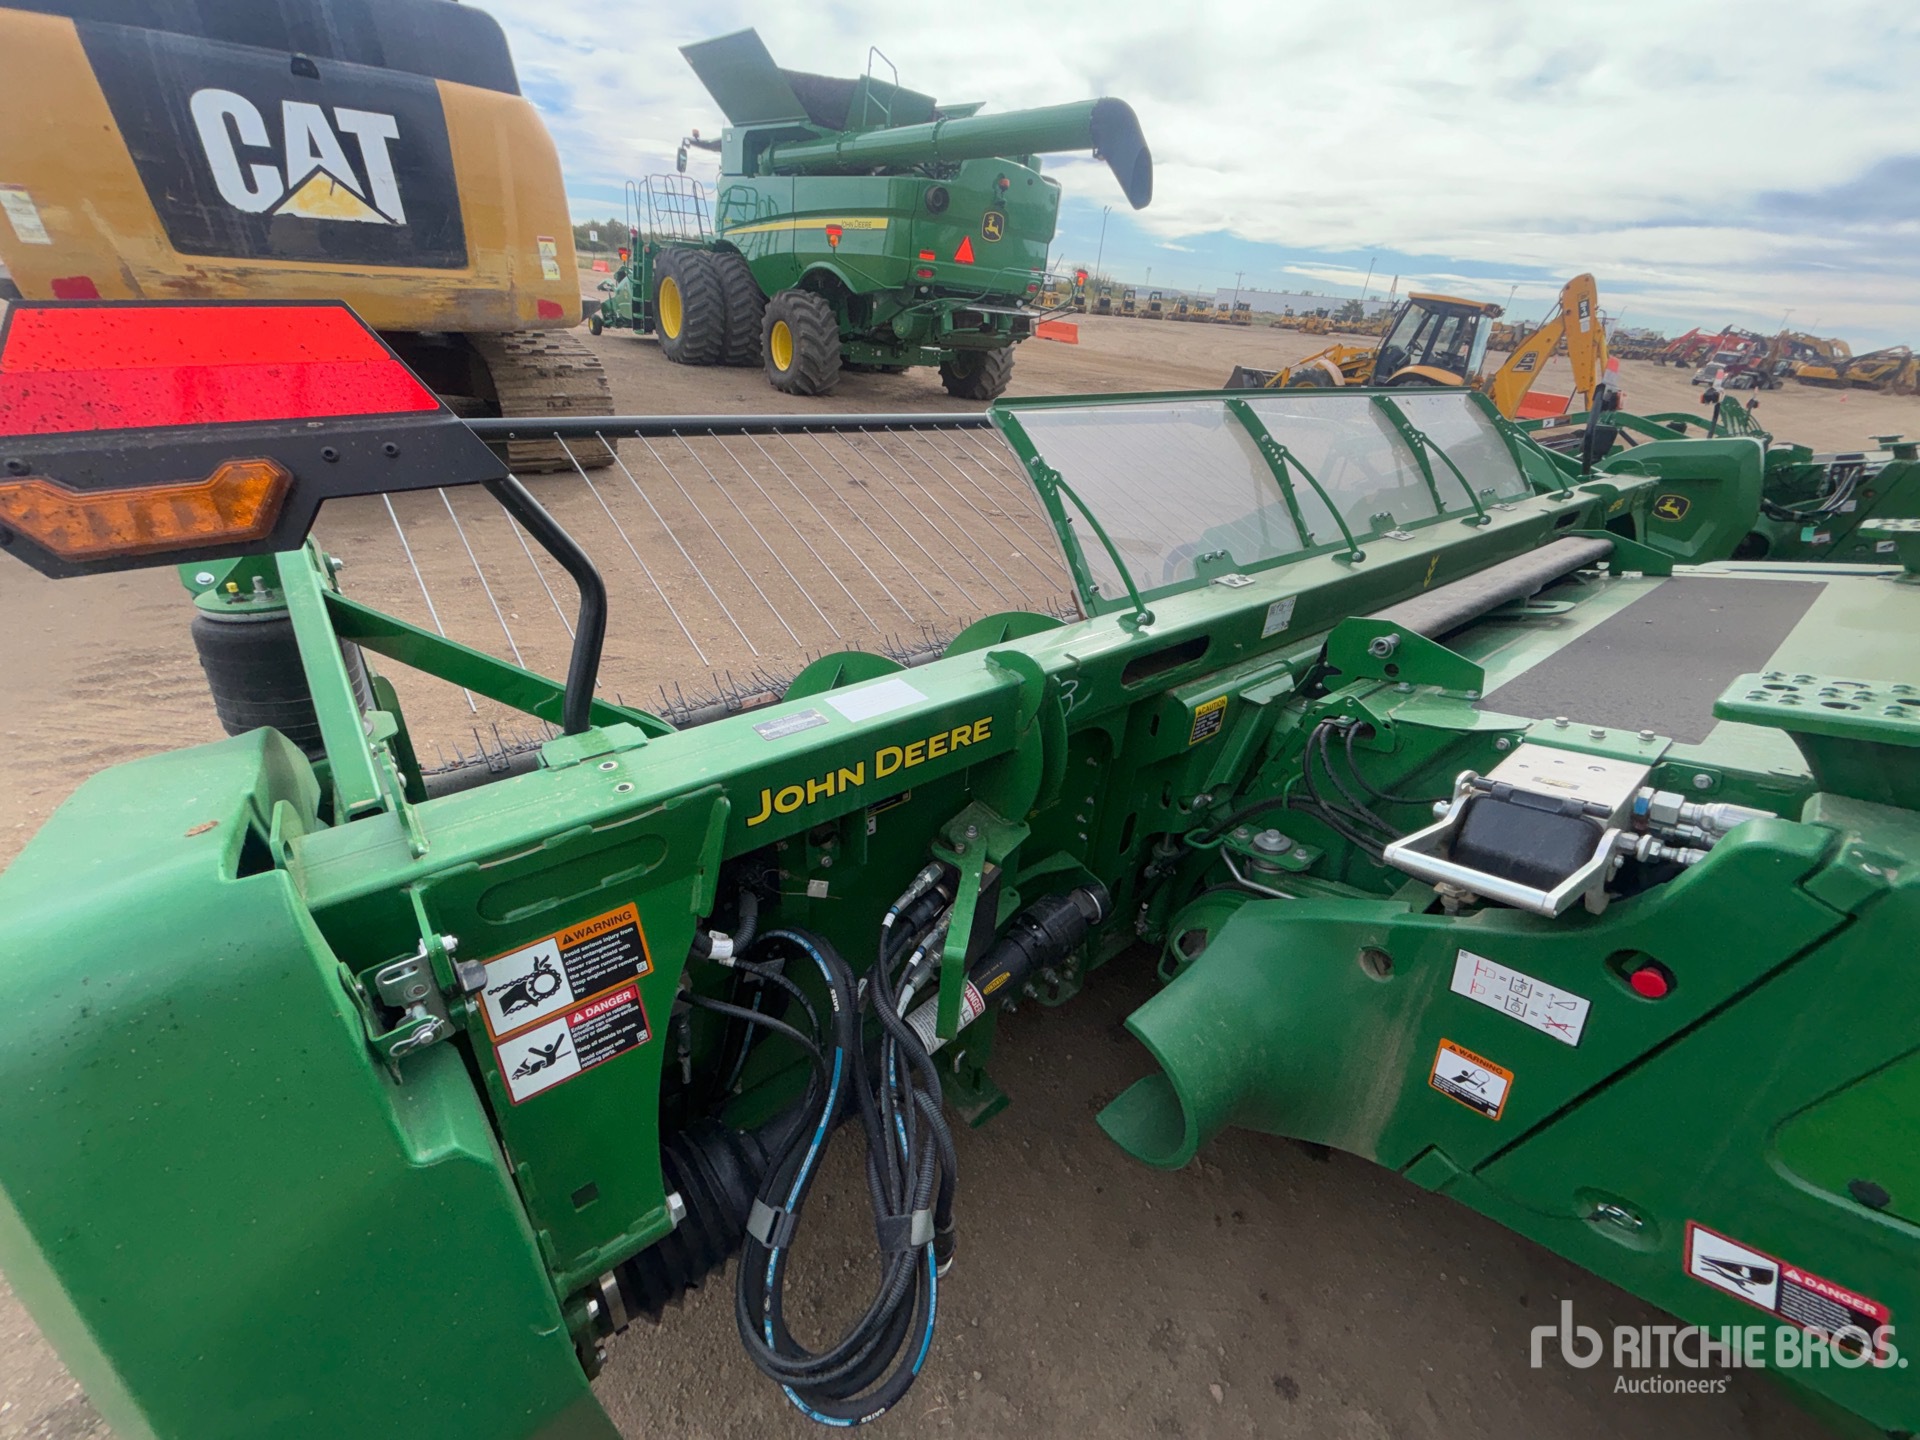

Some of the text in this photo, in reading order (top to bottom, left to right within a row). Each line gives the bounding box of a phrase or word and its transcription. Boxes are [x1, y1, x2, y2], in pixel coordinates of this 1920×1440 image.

[190, 88, 407, 225] CAT
[1514, 352, 1537, 371] JCB
[1201, 698, 1226, 714] CAUTION
[746, 761, 865, 827] JOHN
[875, 716, 993, 780] DEERE
[573, 911, 632, 939] WARNING
[563, 927, 633, 958] Avoid serious injury from
[565, 940, 622, 966] chain entanglement.
[567, 943, 631, 973] Never raise shield with
[580, 965, 600, 976] engine
[600, 955, 624, 967] running.
[571, 955, 639, 988] Stop engine and remove
[585, 991, 632, 1017] DANGER
[831, 988, 840, 1012] GATES
[570, 1015, 606, 1033] Entanglement
[611, 1003, 632, 1014] rotating
[572, 1026, 595, 1038] driveline
[605, 1014, 620, 1023] cause
[620, 1005, 639, 1016] serious
[573, 1034, 589, 1044] injury
[577, 1044, 591, 1053] Keep
[598, 1032, 616, 1043] shields
[580, 1038, 626, 1062] Avoid contact with
[1459, 1048, 1503, 1075] WARNING
[1804, 1277, 1877, 1315] DANGER
[861, 1407, 886, 1423] GATES
